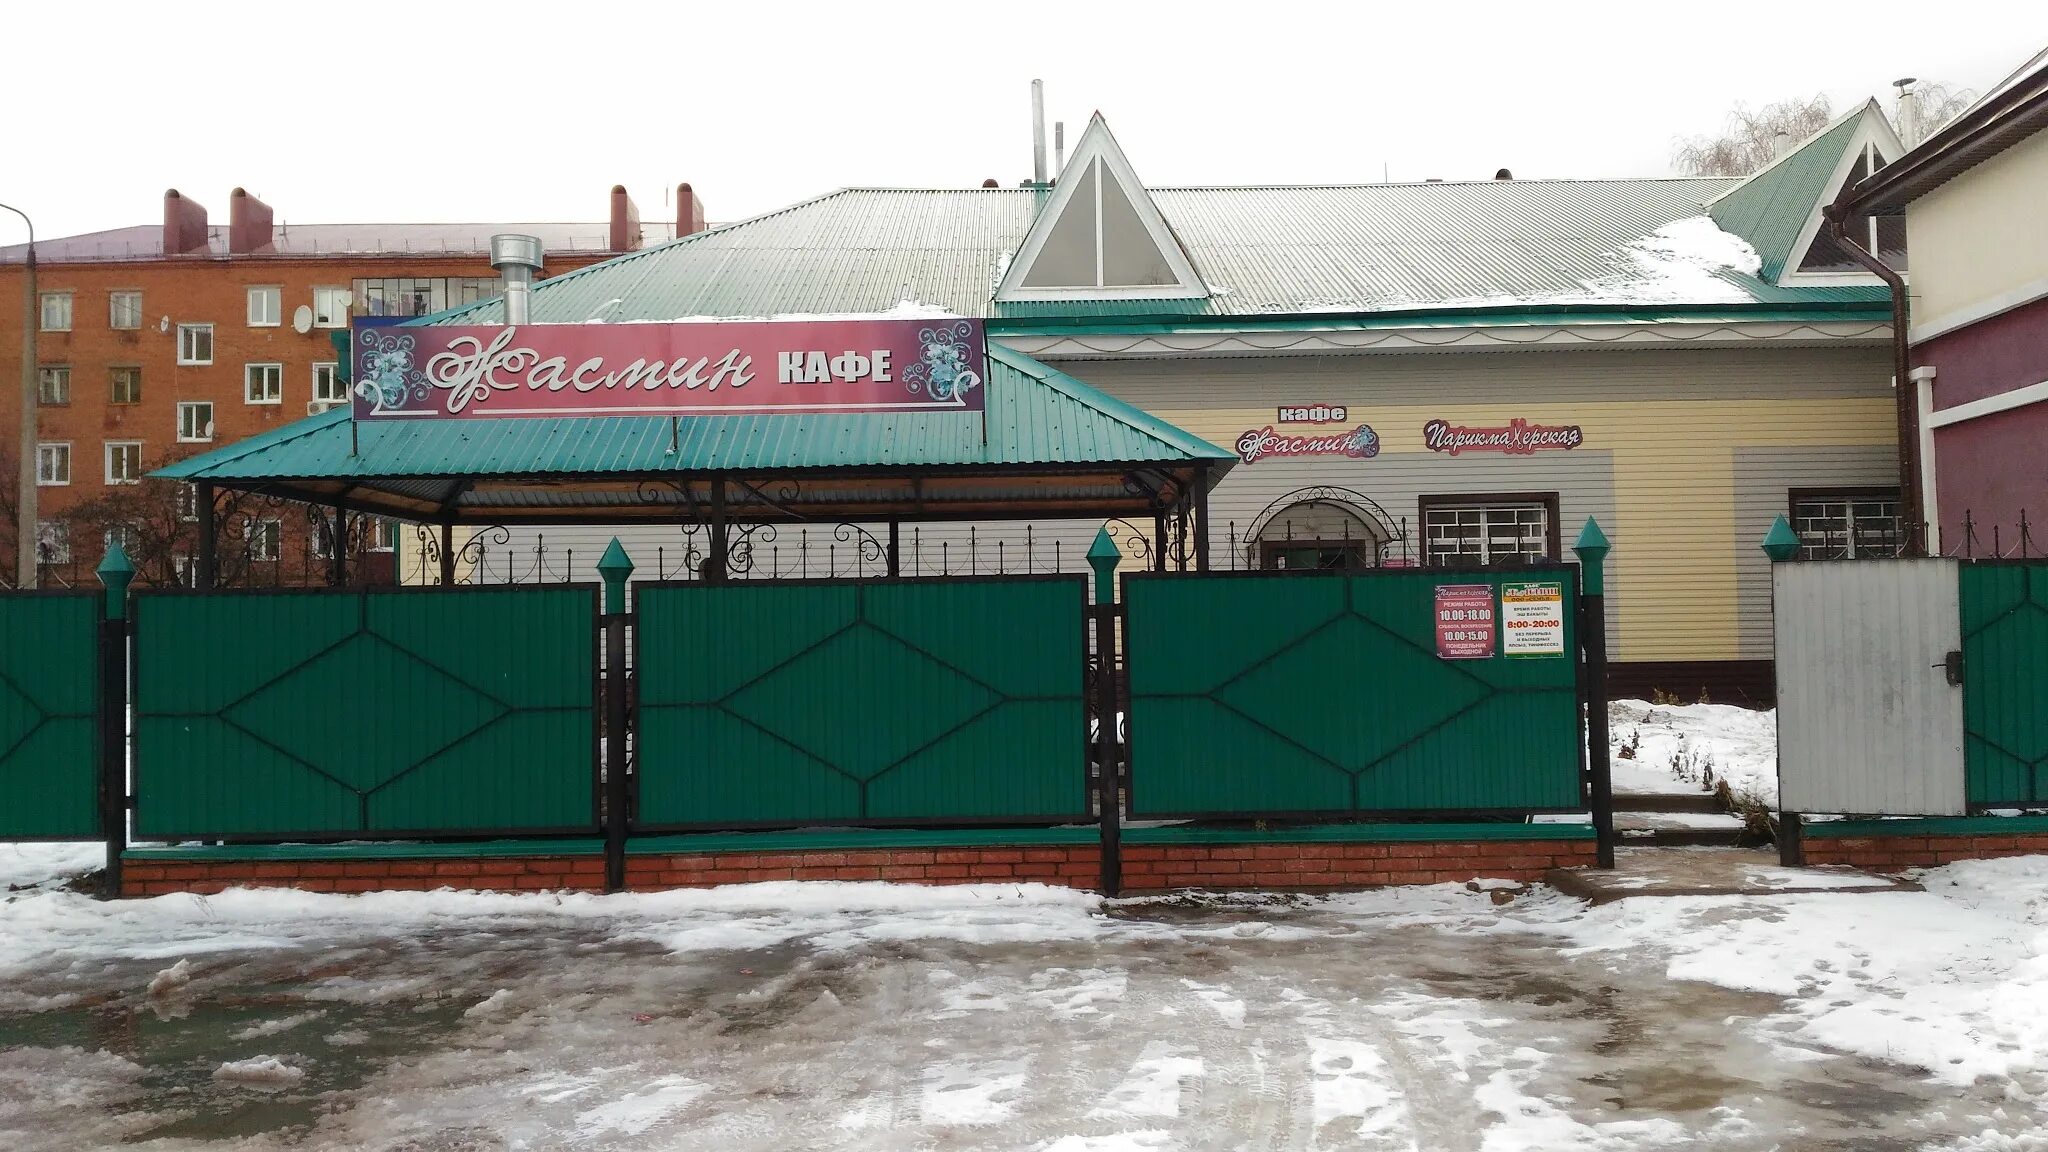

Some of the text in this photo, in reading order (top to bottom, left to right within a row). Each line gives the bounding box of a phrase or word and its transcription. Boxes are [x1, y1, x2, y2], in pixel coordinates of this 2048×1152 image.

[425, 325, 893, 414] Жасмин КАФЕ
[1238, 428, 1361, 462] Жасмин
[1439, 609, 1491, 621] 10.00-18.00
[1507, 620, 1560, 629] 8:00-20:00
[1444, 631, 1488, 641] 10.00-15.00
